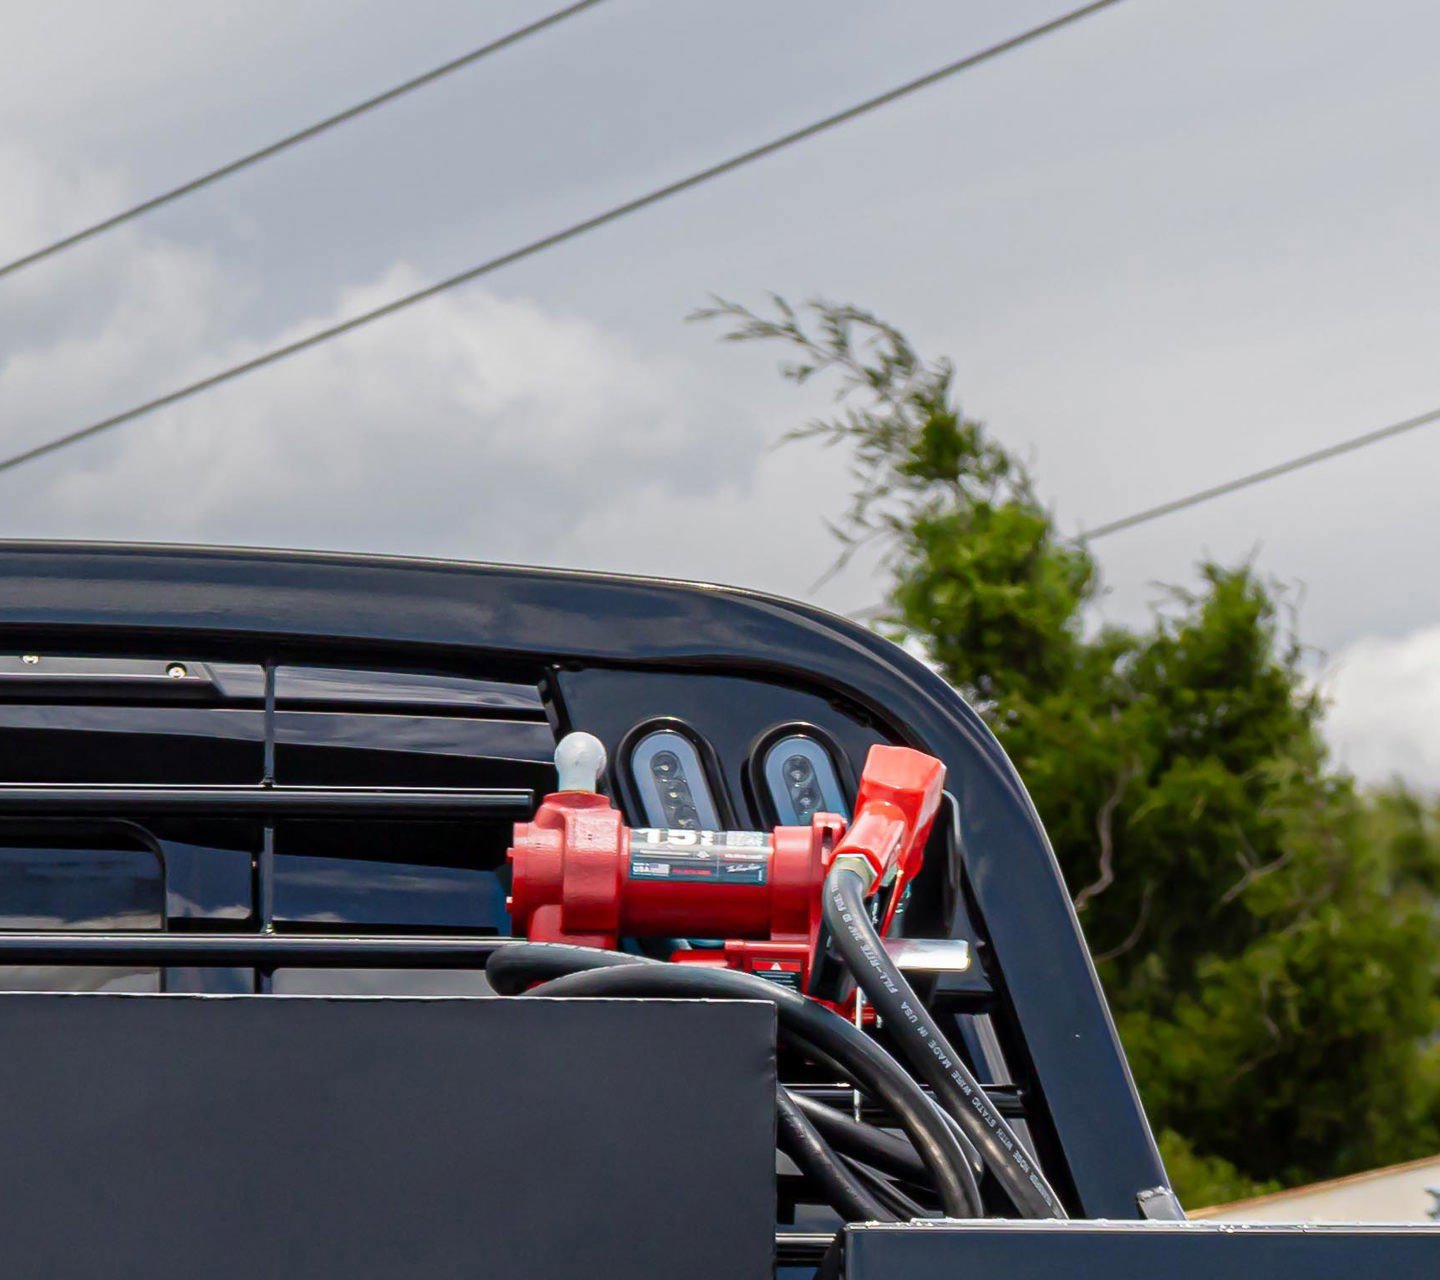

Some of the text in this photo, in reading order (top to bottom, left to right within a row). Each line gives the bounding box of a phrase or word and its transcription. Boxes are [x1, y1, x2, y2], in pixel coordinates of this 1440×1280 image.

[900, 1001, 919, 1024] USA
[917, 1026, 929, 1038] IN
[927, 1039, 952, 1070] MADE
[951, 1070, 973, 1096] WIRE
[971, 1096, 997, 1128] STATIC
[995, 1127, 1014, 1151] WITH
